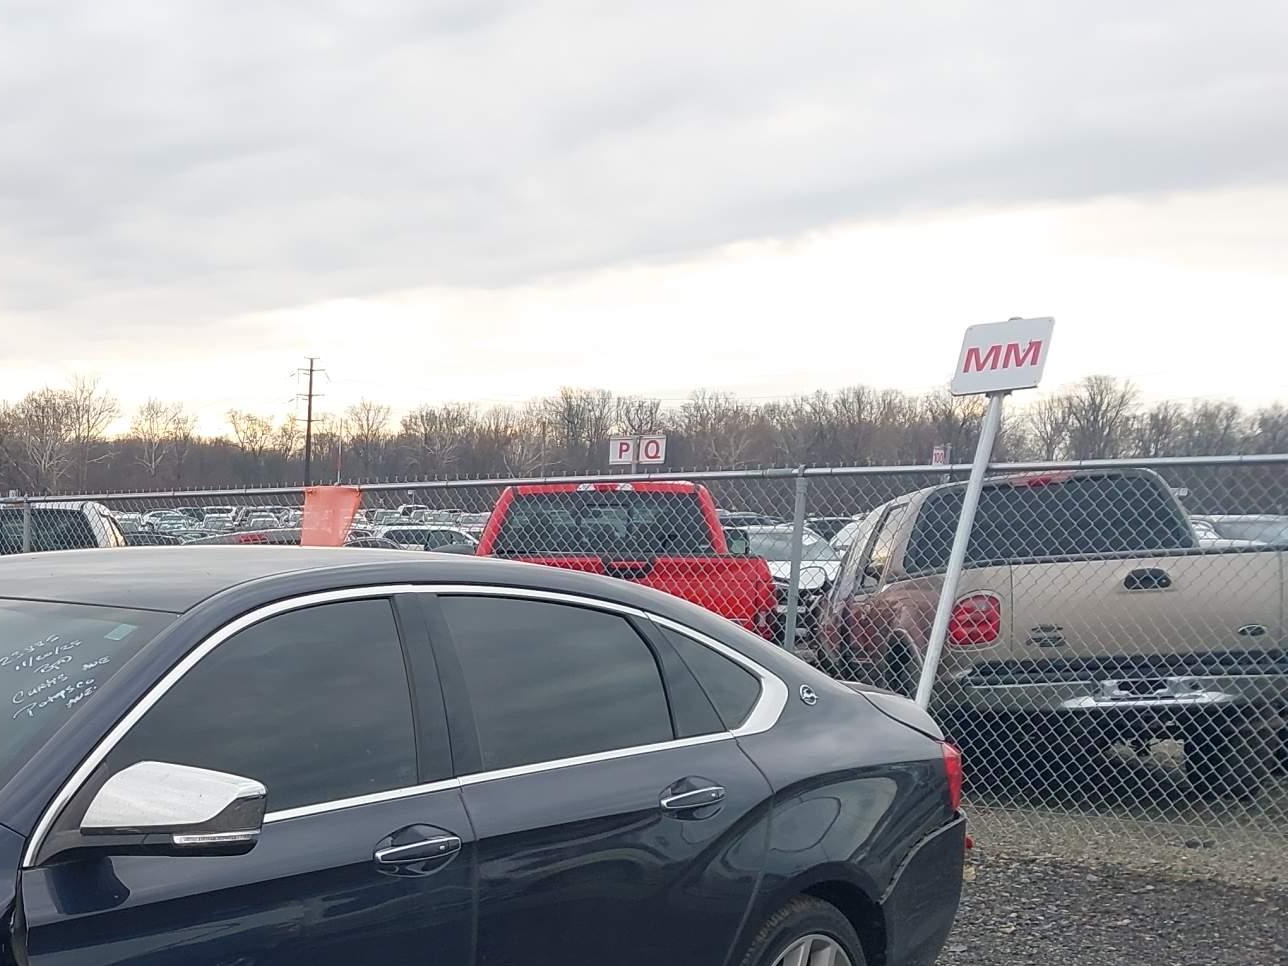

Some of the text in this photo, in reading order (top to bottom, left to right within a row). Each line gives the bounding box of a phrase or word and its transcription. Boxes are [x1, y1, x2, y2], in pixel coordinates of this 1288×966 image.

[963, 340, 1042, 373] MM
[618, 442, 630, 459] P
[644, 440, 661, 459] Q
